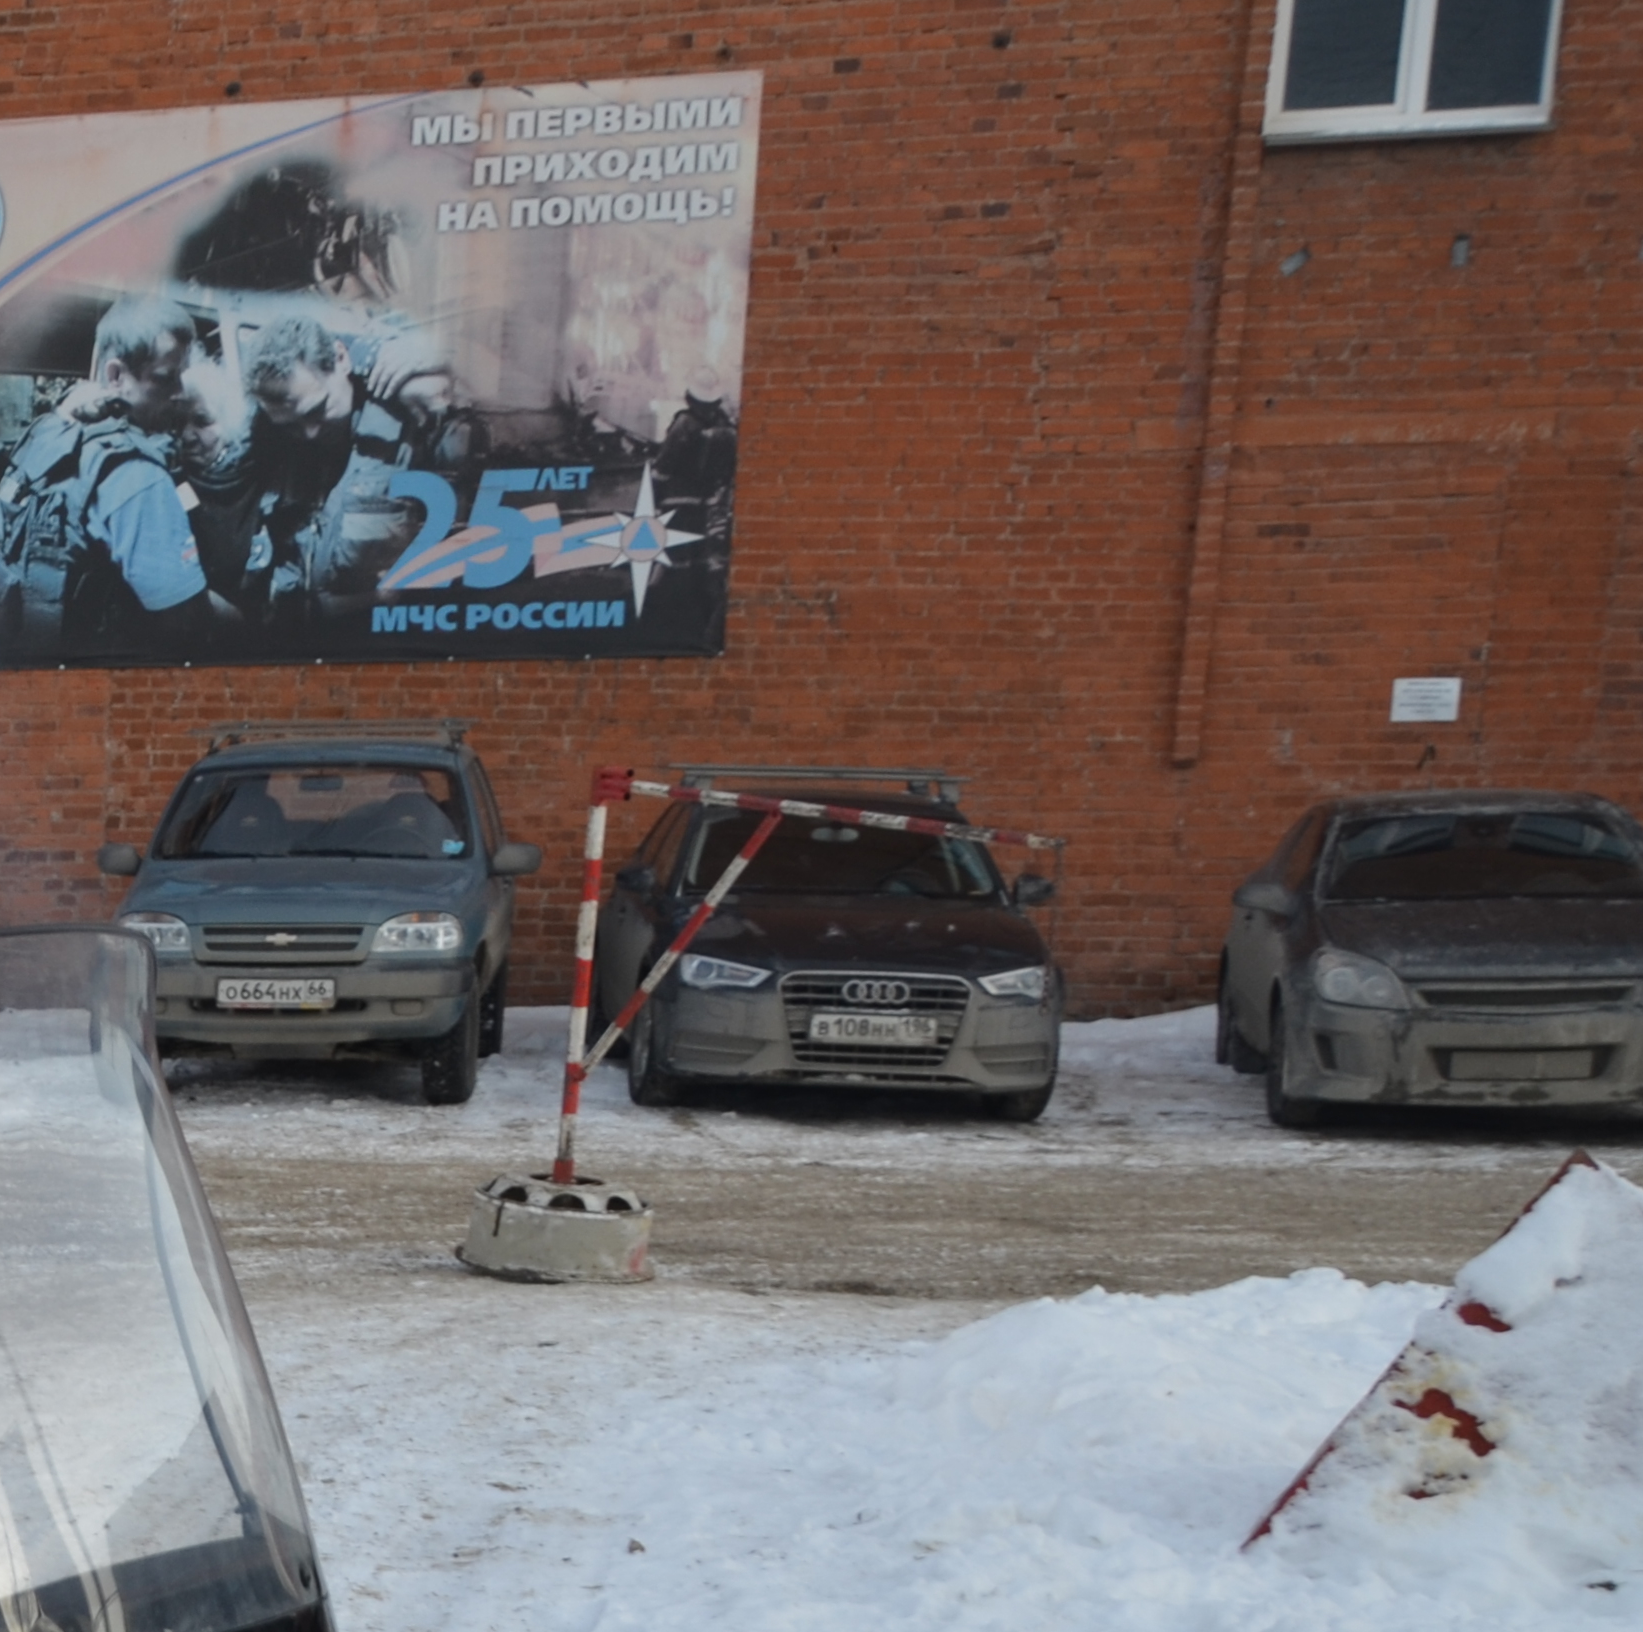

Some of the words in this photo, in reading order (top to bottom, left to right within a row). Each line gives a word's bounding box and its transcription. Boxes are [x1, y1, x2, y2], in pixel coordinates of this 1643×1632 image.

[412, 112, 494, 146] МЫ
[505, 97, 743, 140] ПЕРВЫМИ
[472, 142, 739, 187] ПРИХОДИМ
[437, 200, 499, 232] НА
[510, 187, 735, 229] ПОМОЩЬ!
[376, 468, 541, 591] 25
[536, 466, 594, 490] ЛЕТ
[371, 603, 459, 633] МЧС
[465, 600, 626, 631] РОССИИ
[308, 981, 327, 995] 66
